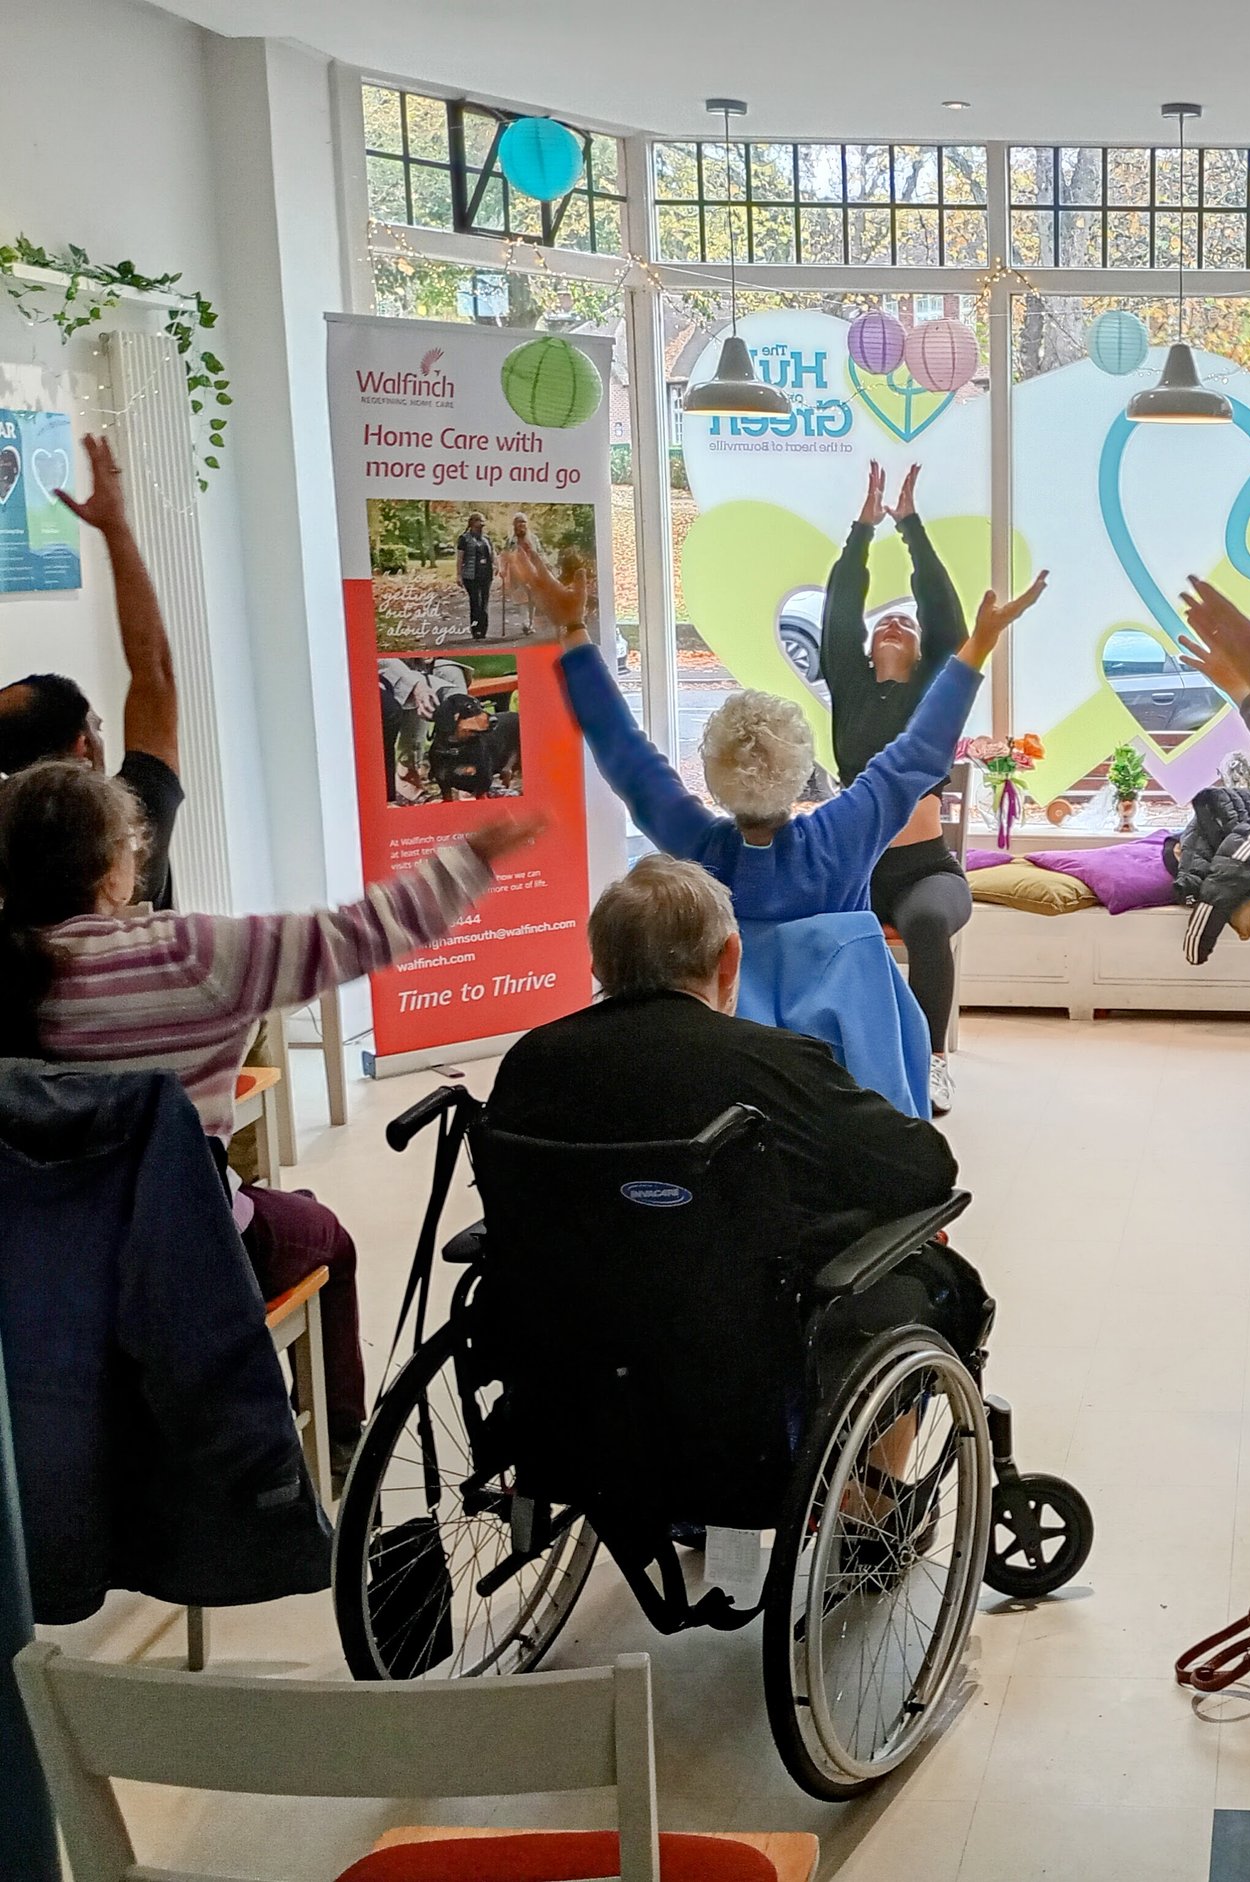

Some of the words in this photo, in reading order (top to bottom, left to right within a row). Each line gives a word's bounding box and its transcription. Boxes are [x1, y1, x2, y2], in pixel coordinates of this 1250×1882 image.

[356, 370, 455, 398] Walfinch
[364, 424, 433, 448] Home
[440, 427, 489, 450] Care
[496, 431, 543, 452] with
[366, 461, 426, 479] more
[432, 460, 469, 486] get
[476, 464, 503, 487] up
[509, 462, 549, 483] and
[555, 467, 581, 489] go
[387, 619, 431, 637] about
[527, 869, 541, 878] can
[396, 952, 476, 973] walfinch.com
[398, 988, 453, 1013] Time
[460, 983, 485, 1002] to
[492, 970, 557, 997] Thrive
